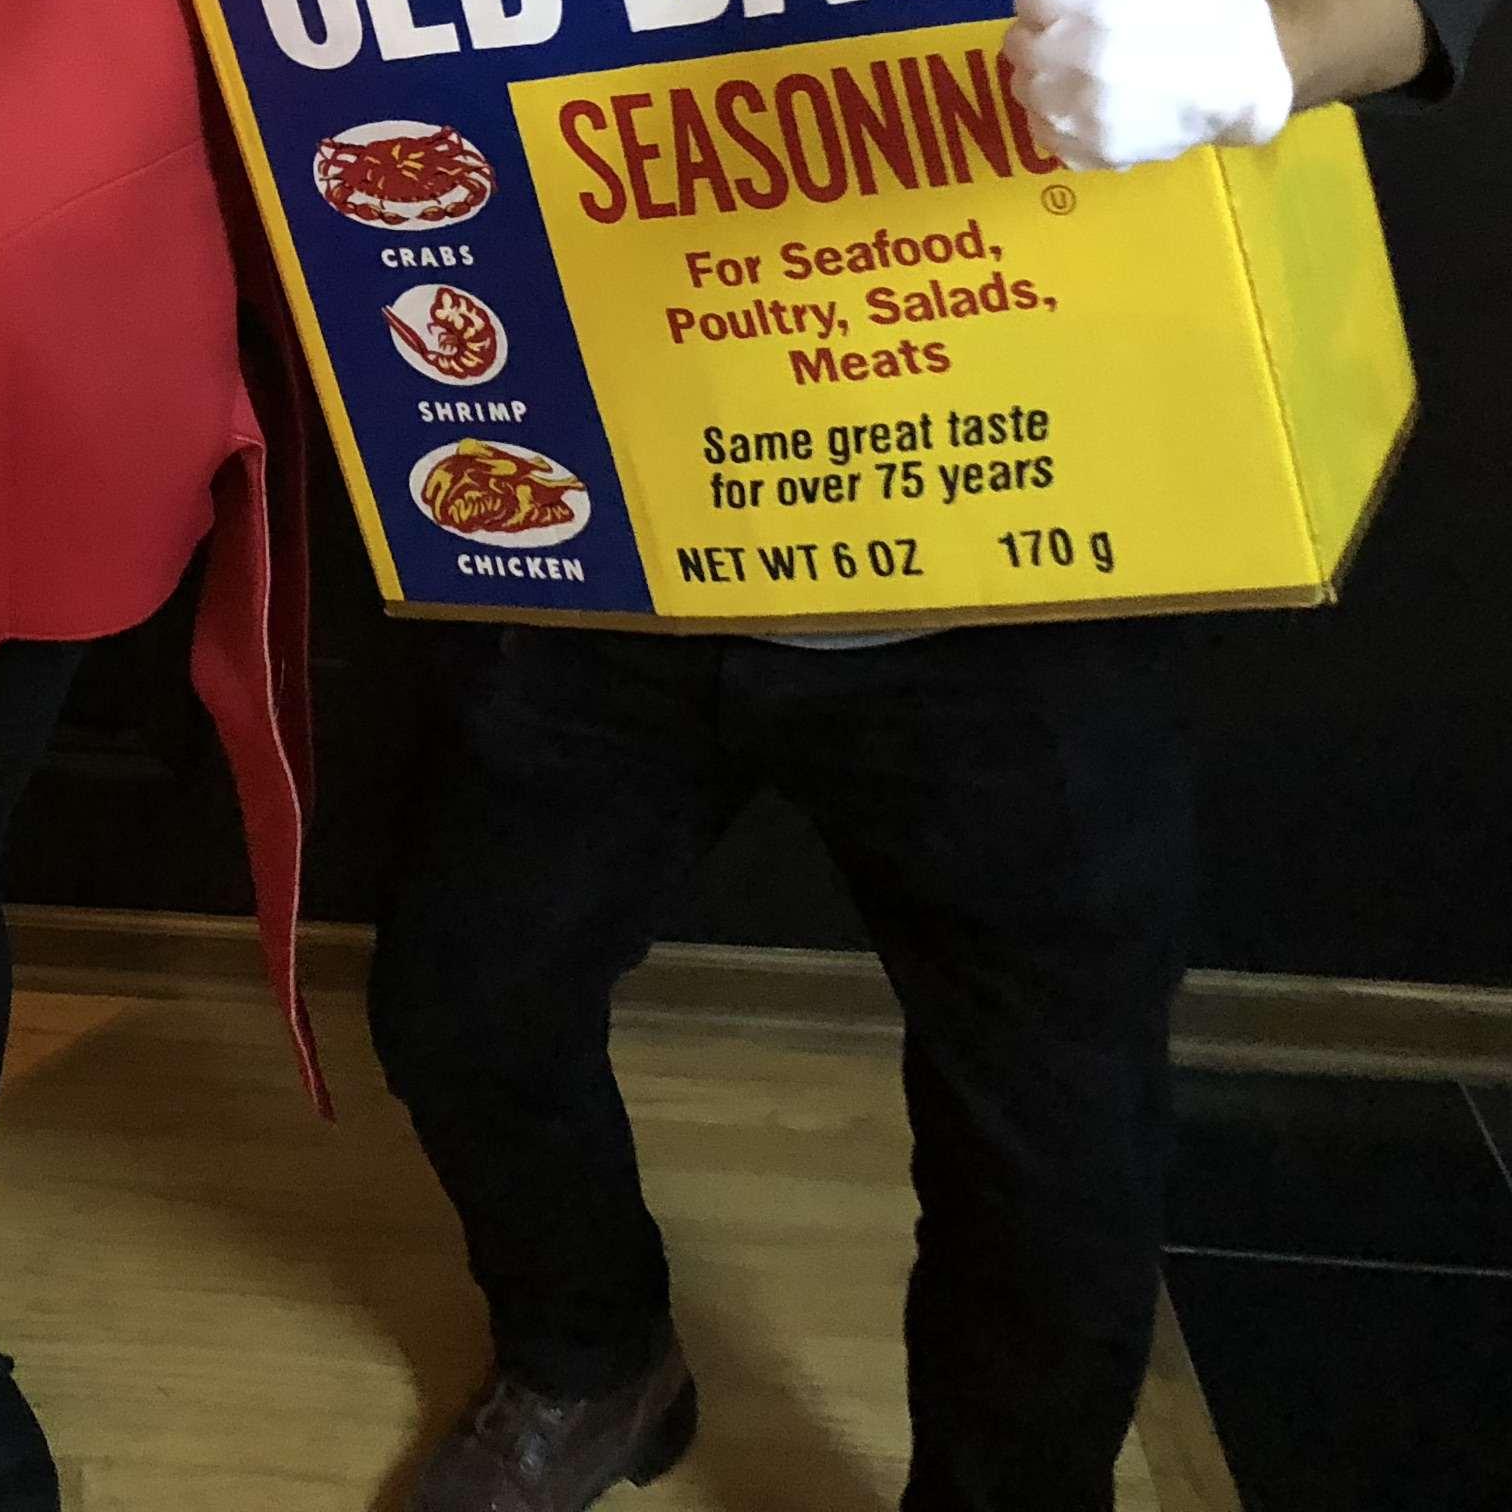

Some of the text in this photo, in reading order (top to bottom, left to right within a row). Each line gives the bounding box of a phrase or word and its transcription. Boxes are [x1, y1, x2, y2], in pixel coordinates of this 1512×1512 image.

[381, 245, 474, 269] CRABS
[686, 220, 1003, 289] For Seafood,
[666, 271, 1057, 344] Poultry, Salads,
[789, 337, 950, 385] Meats
[418, 400, 527, 424] SHRIMP
[704, 405, 1050, 466] Same great taste
[710, 454, 1054, 509] for over 75 years
[457, 554, 584, 582] CHICKEN
[677, 527, 1115, 583] NET WT 6 OZ 170 g
